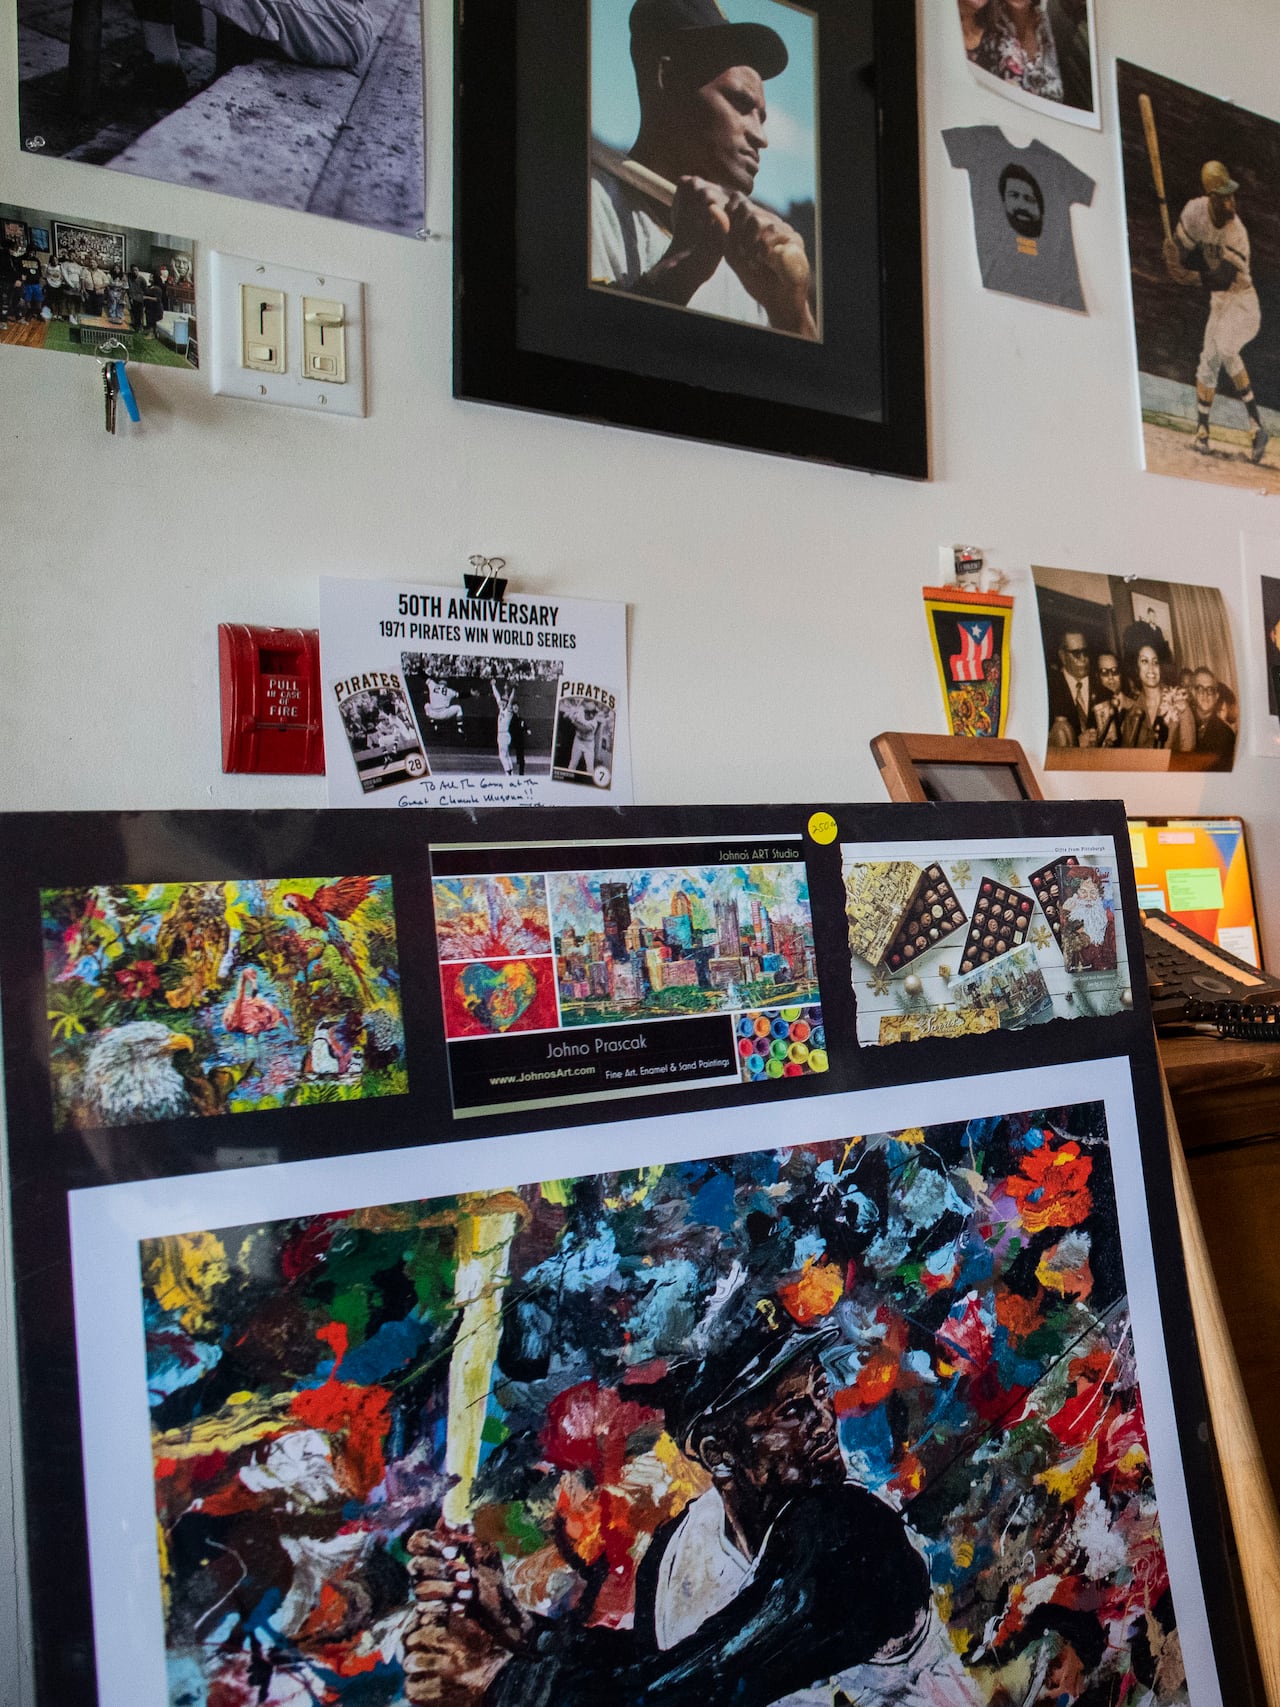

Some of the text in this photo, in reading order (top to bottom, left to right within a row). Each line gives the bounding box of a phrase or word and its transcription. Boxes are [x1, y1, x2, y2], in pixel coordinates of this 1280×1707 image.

[398, 593, 559, 627] 50TH ANNIVERSARY
[379, 620, 577, 650] 1971 PIRATES WIN WORLD SERIES
[269, 679, 299, 690] PULL
[334, 672, 401, 702] PIRATES
[267, 690, 301, 700] IN CASE
[560, 681, 616, 709] PIRATES
[270, 705, 298, 717] FIRE
[408, 758, 423, 771] 28
[599, 771, 605, 782] 7
[719, 848, 799, 861] Johno's ART Studio
[546, 1034, 648, 1059] Johno Prascak
[488, 1065, 596, 1086] www.JohnosArt.com
[605, 1070, 623, 1079] Fine
[640, 1064, 668, 1076] Enamel
[669, 1063, 677, 1072] &
[679, 1060, 697, 1071] Sand
[698, 1059, 730, 1068] Paintings
